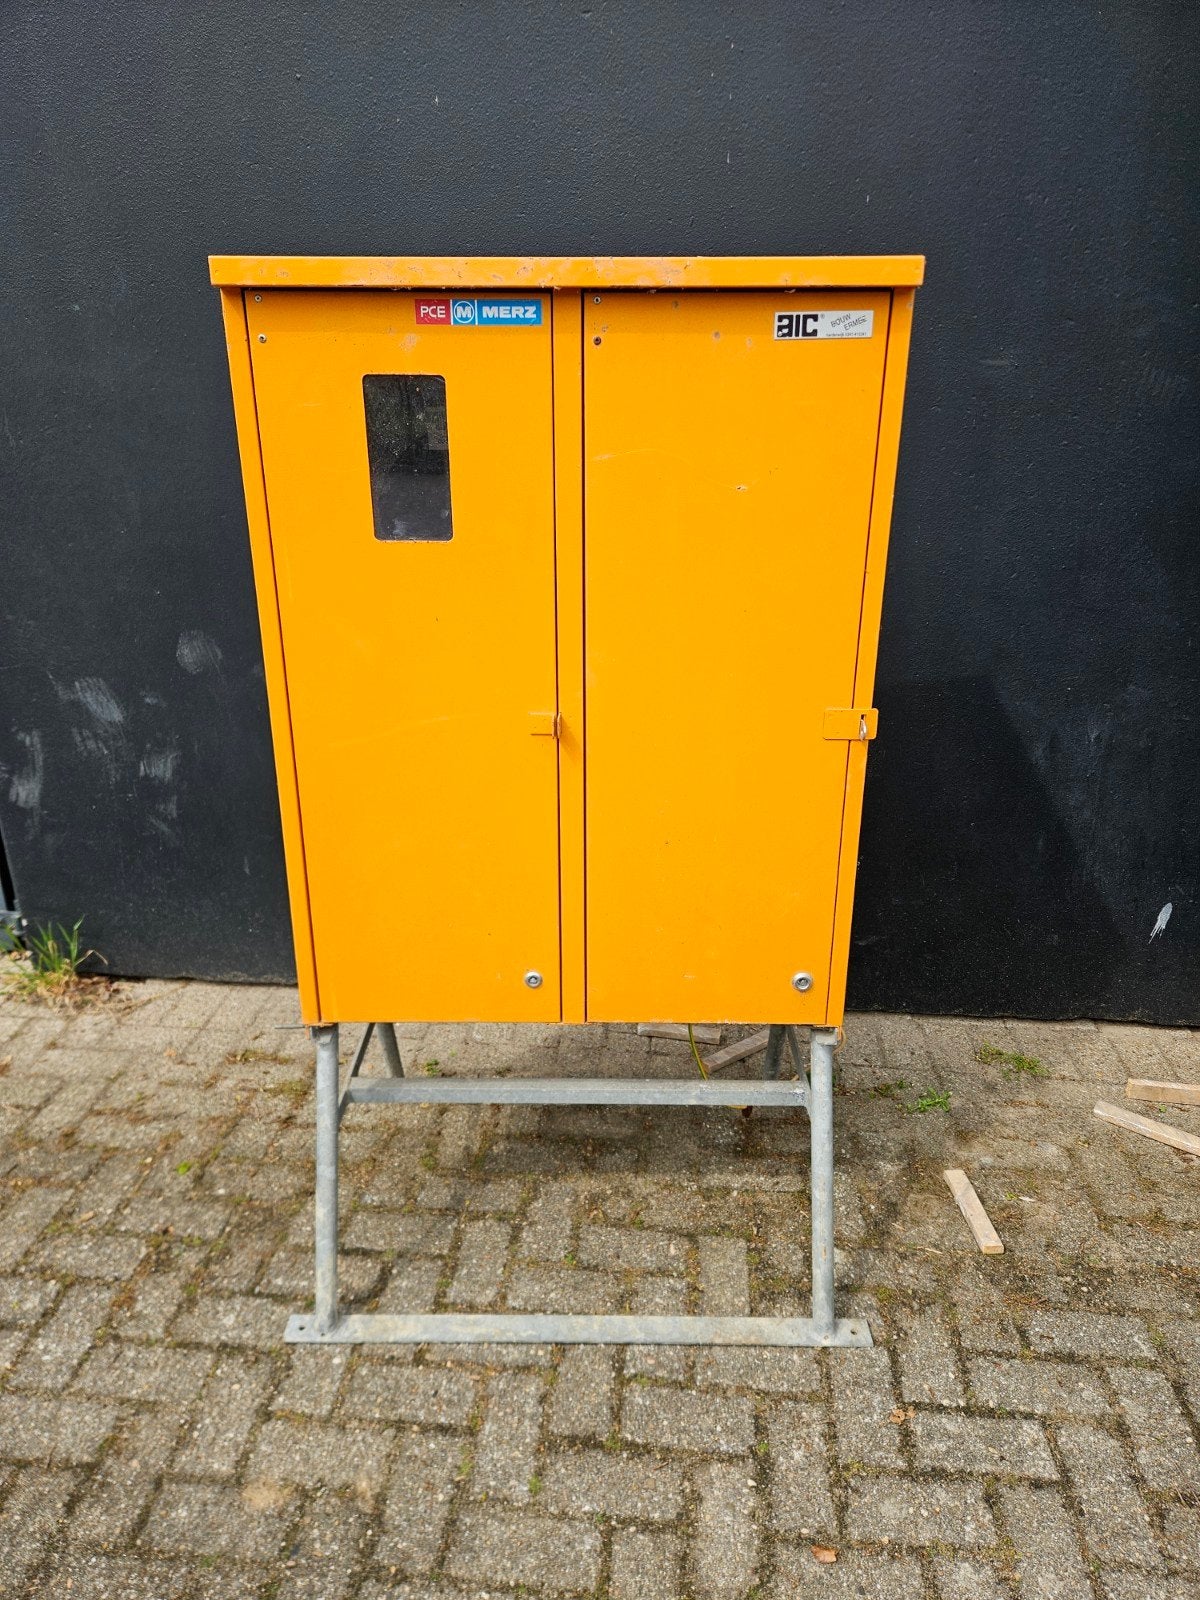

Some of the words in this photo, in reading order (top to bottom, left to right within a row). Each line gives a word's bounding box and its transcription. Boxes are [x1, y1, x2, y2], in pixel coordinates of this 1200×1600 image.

[420, 306, 446, 318] PCE
[456, 306, 472, 318] M
[482, 306, 537, 318] MERZ
[830, 313, 851, 328] BOUW
